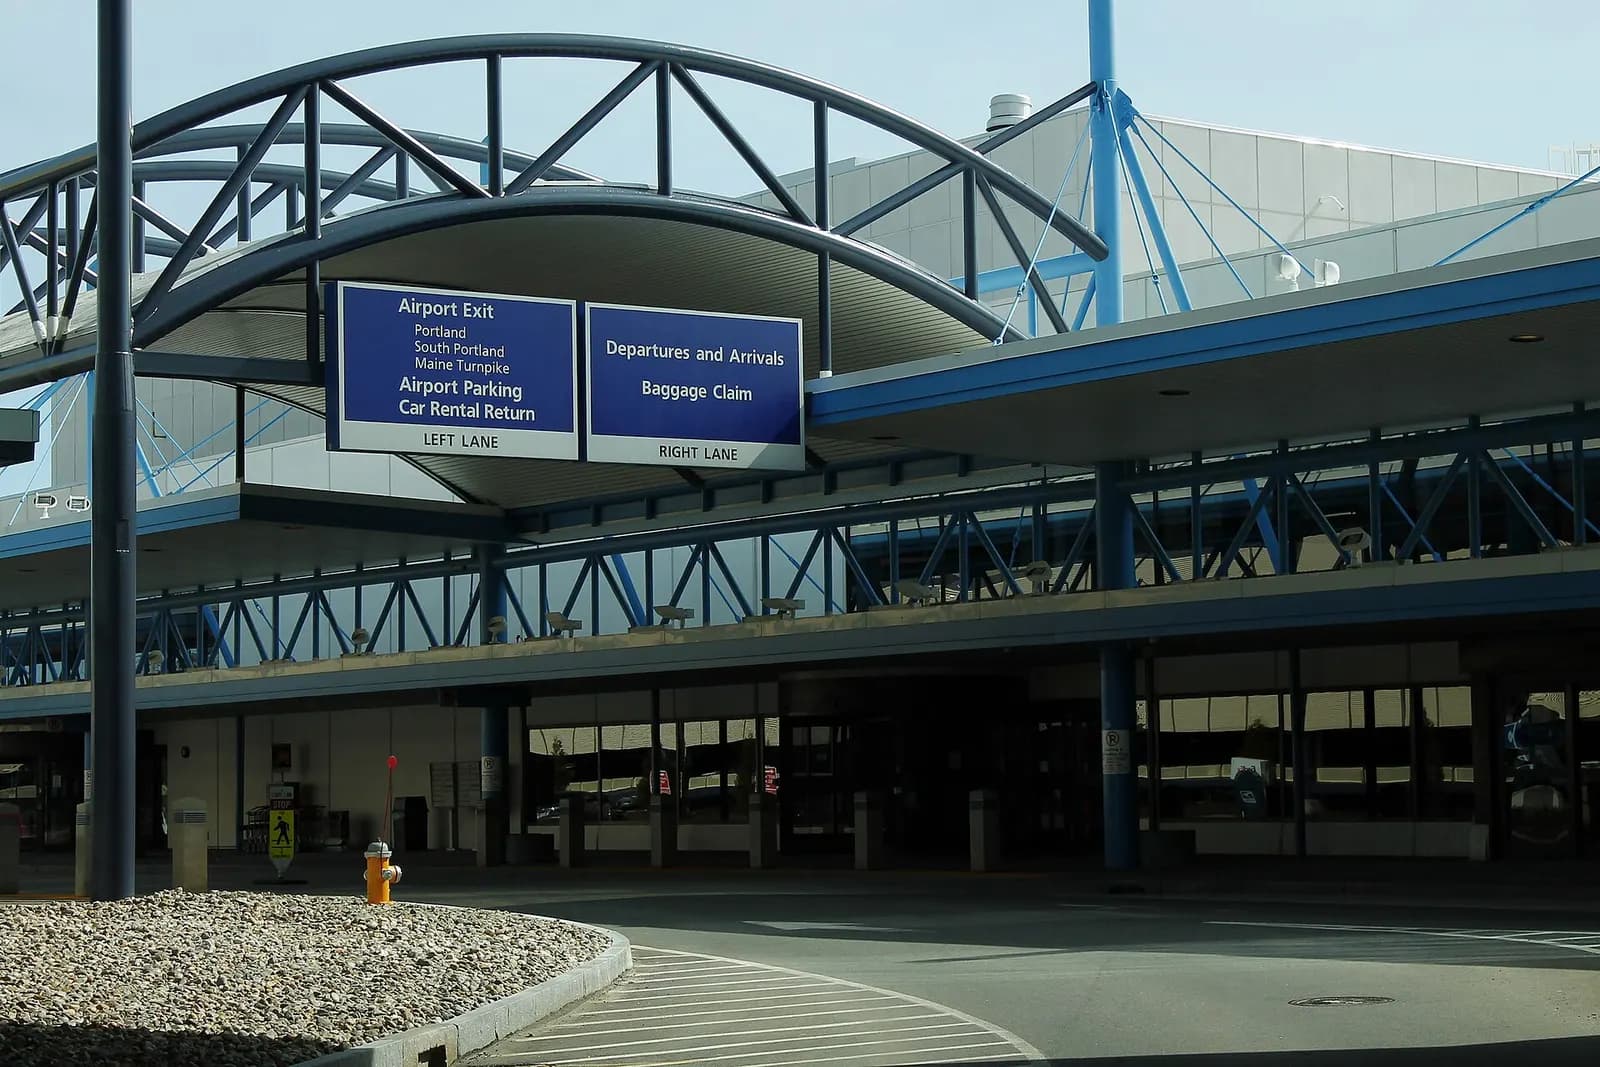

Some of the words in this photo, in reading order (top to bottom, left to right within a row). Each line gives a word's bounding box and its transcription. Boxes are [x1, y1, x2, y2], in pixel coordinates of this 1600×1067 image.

[398, 297, 458, 319] Airport
[463, 302, 495, 319] Exit
[415, 324, 466, 339] Portland
[414, 340, 450, 355] South
[454, 342, 505, 358] Portland
[606, 339, 690, 360] Departures
[696, 346, 723, 363] and
[729, 348, 784, 367] Arrivals
[415, 356, 454, 371] Maine
[457, 359, 510, 376] Turnpike
[399, 376, 459, 397] Airport
[463, 380, 522, 402] Parking
[642, 380, 708, 403] Baggage
[712, 384, 753, 402] Claim
[399, 399, 426, 416] Car
[430, 401, 480, 418] Rental
[484, 404, 536, 422] Return
[424, 432, 456, 447] LEFT
[461, 434, 499, 449] LANE
[659, 444, 699, 459] RIGHT
[704, 447, 738, 461] LANE
